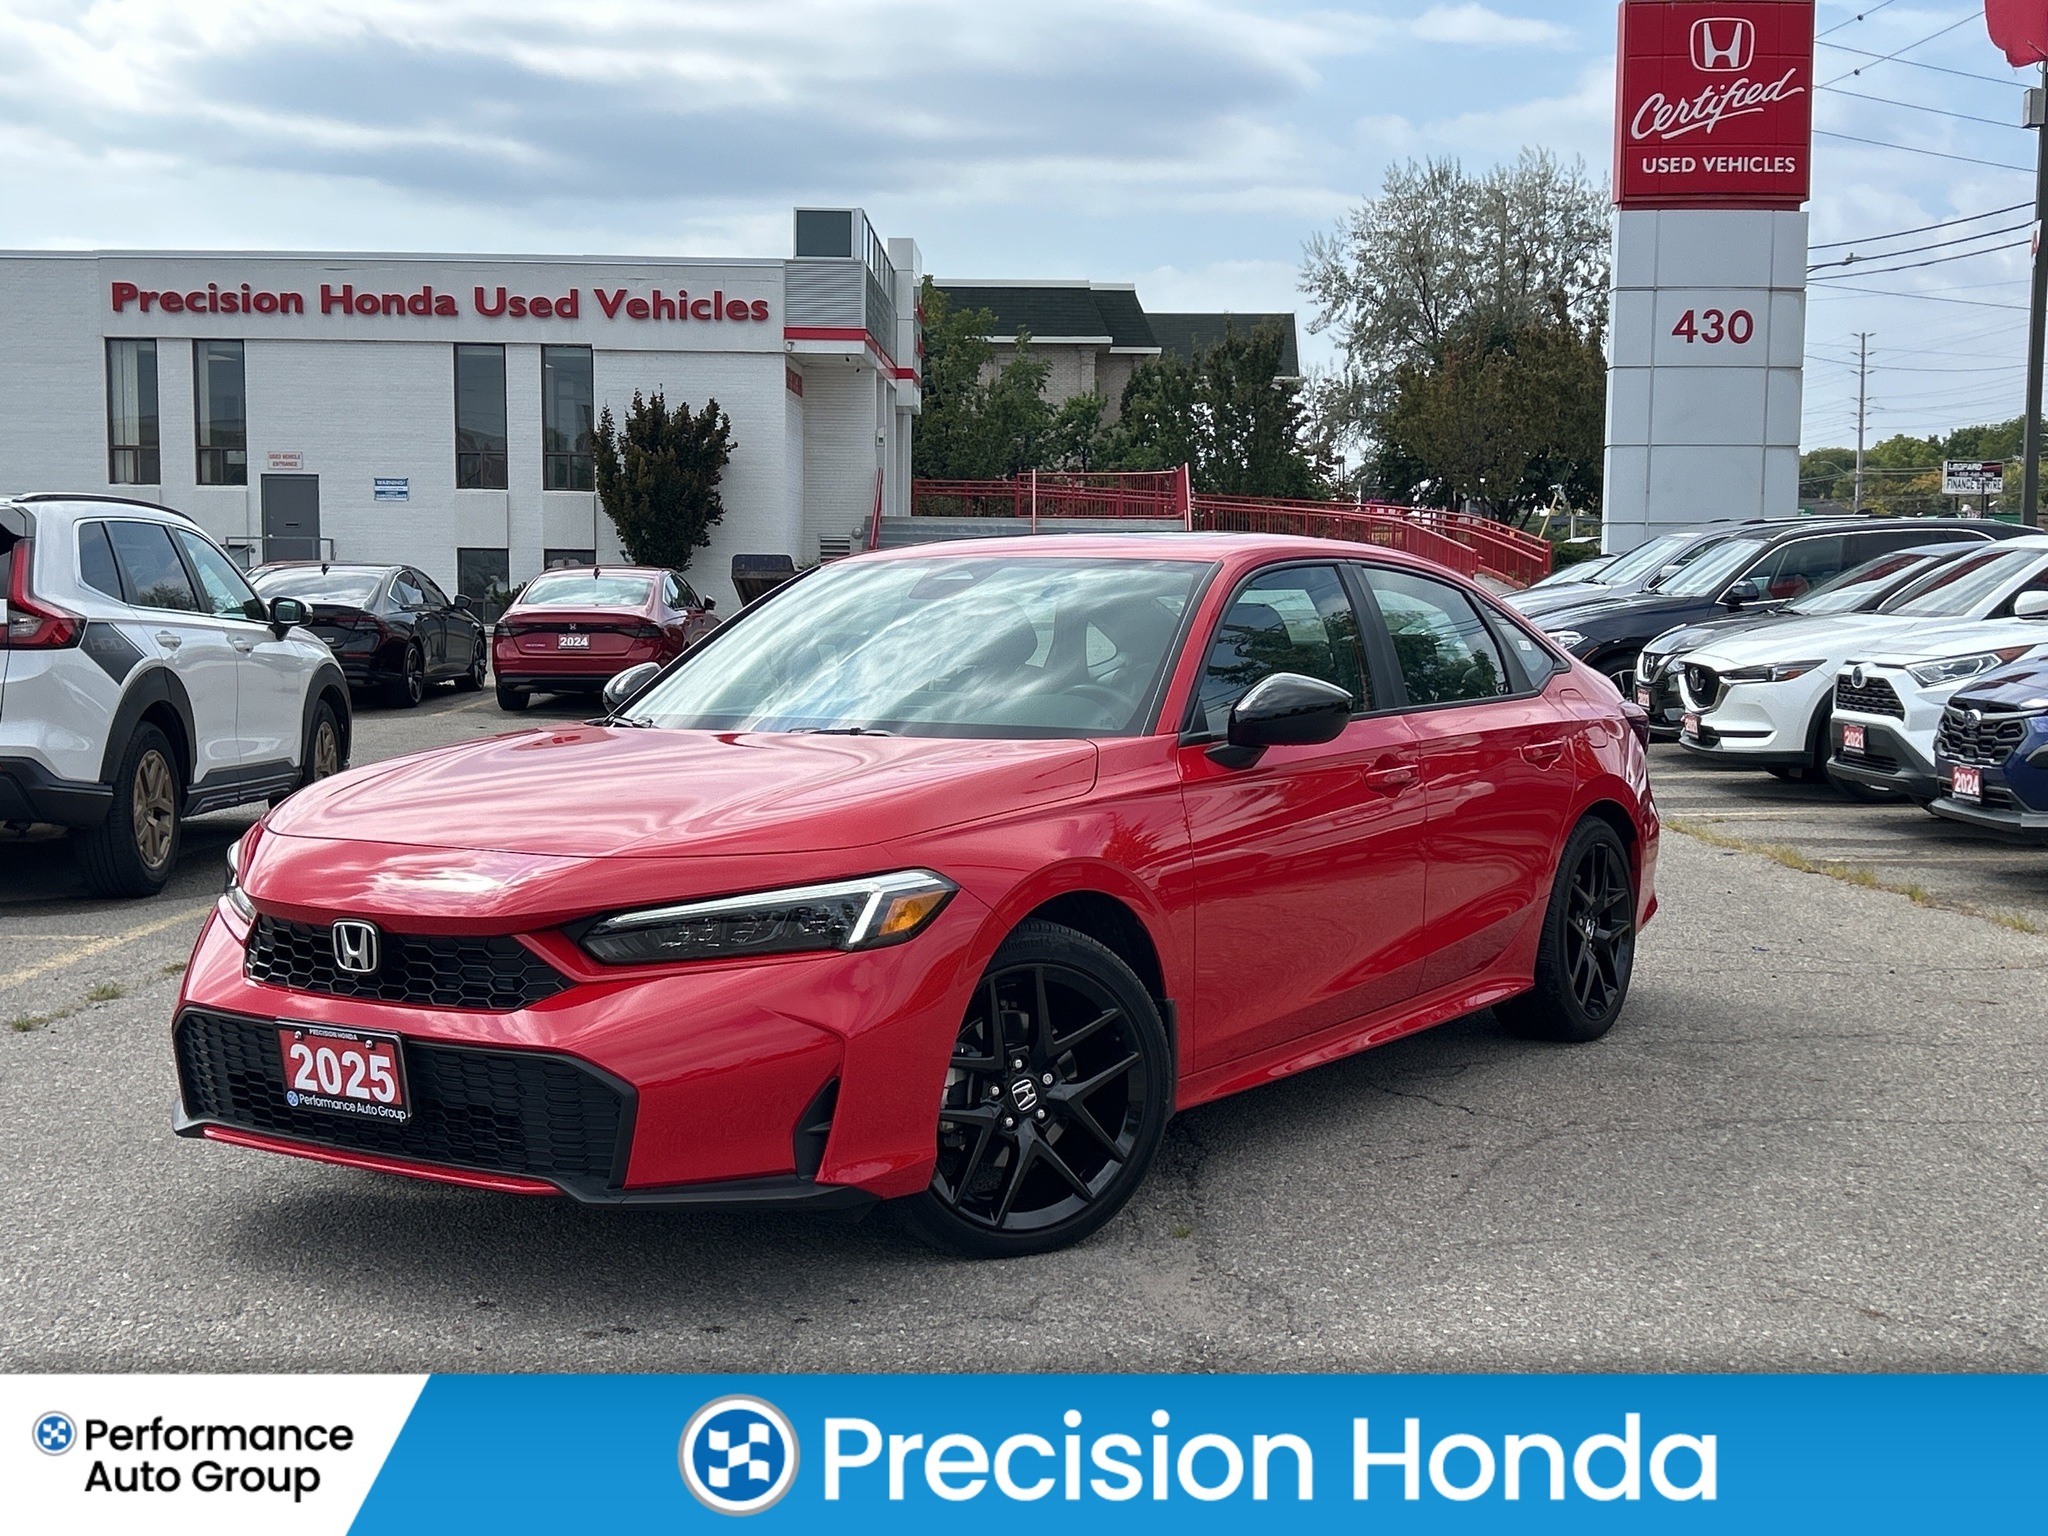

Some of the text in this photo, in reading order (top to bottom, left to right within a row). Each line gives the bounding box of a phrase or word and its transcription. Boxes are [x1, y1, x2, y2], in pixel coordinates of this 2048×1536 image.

[1631, 67, 1805, 141] Certified
[1642, 156, 1796, 174] USED VEHICLES
[111, 281, 770, 322] Precision Honda Used Vehicles
[1671, 309, 1754, 345] 430
[1948, 463, 1983, 471] LEOPARD
[1947, 478, 2002, 490] FINANCE CNTRE
[89, 638, 124, 650] HPD
[560, 637, 588, 646] 2024
[1844, 730, 1864, 749] 2021
[1954, 771, 1980, 796] 2024
[308, 1028, 359, 1041] PRECISION HONDA
[290, 1043, 396, 1103] 2025
[299, 1093, 406, 1123] Performance Auto Group
